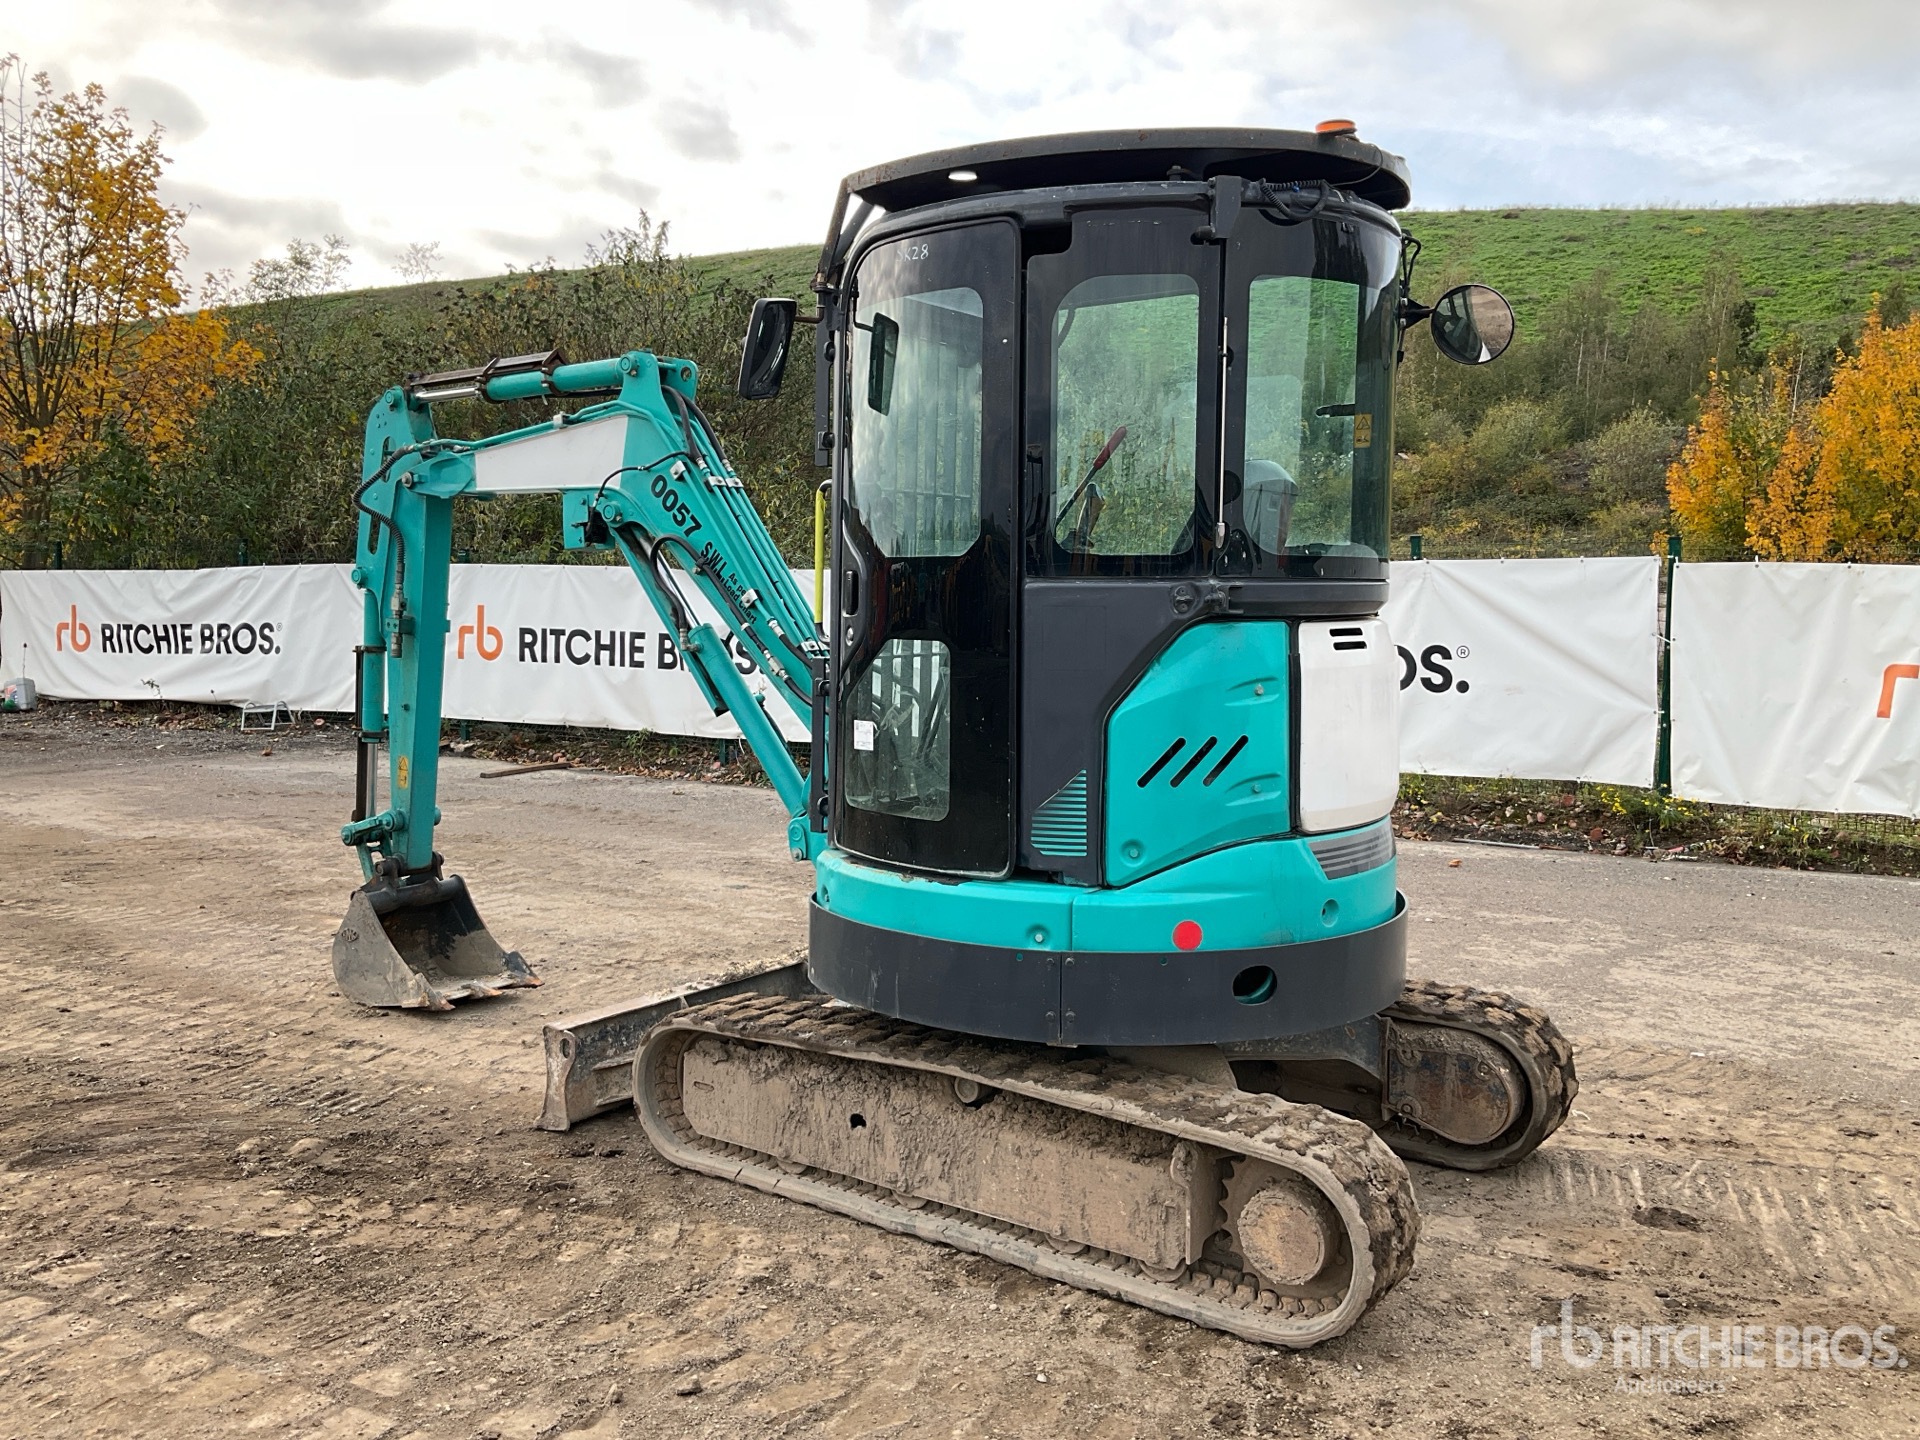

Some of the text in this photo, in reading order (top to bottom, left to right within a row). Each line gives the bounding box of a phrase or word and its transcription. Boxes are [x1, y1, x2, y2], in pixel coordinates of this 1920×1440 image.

[651, 474, 703, 537] 0057
[724, 578, 740, 602] Load
[728, 572, 747, 597] As pe
[56, 604, 91, 652] rb
[101, 623, 192, 655] RITCHIE
[457, 604, 503, 661] rb
[518, 627, 646, 668] RITCHIE
